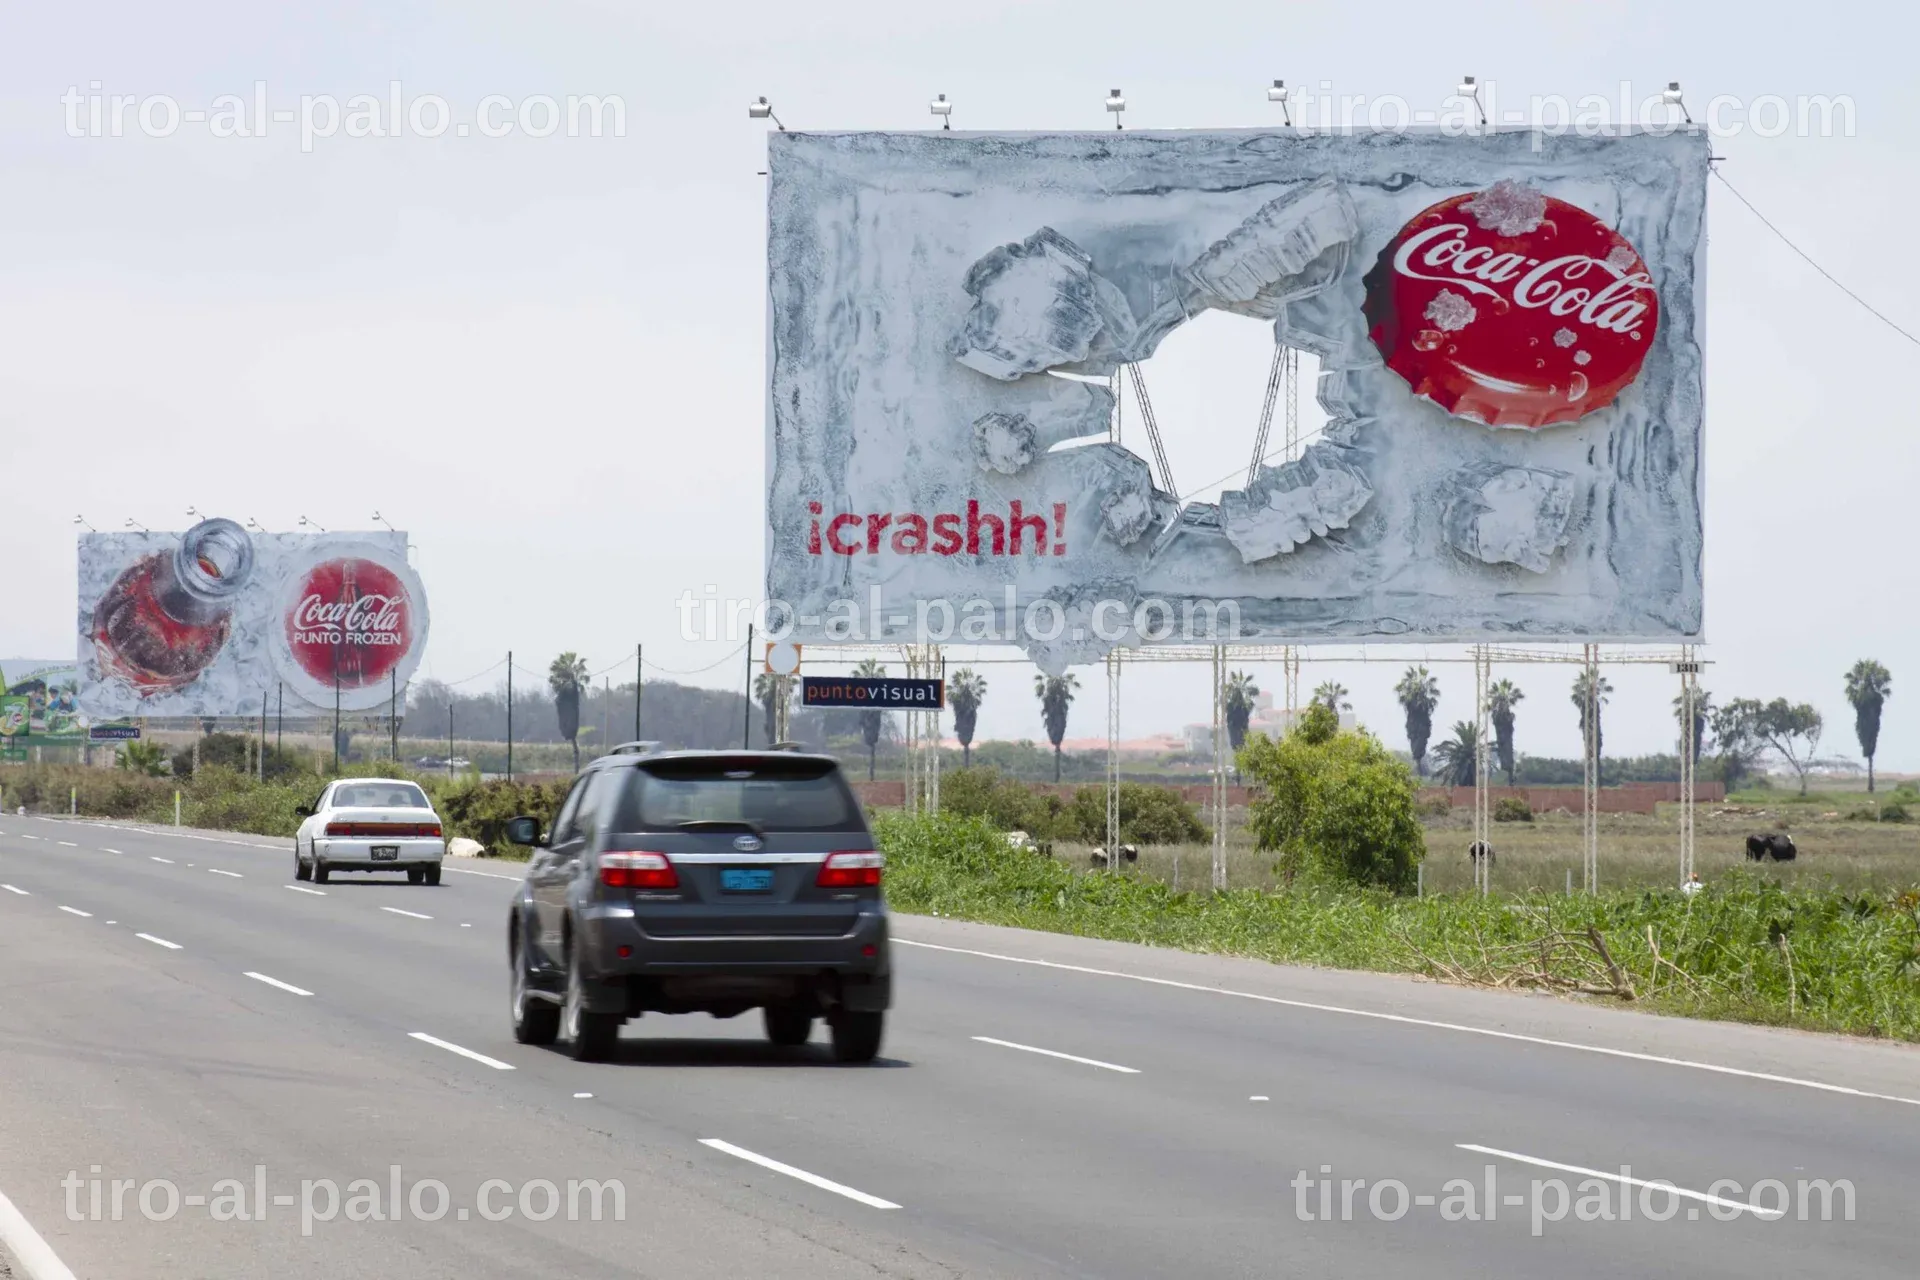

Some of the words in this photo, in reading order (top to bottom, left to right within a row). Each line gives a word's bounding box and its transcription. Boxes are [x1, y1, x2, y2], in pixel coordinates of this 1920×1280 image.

[1393, 223, 1656, 333] Coca-Cola
[294, 594, 403, 631] Coca-Cola
[294, 631, 341, 644] PUNTO
[345, 631, 402, 645] FROZEN
[807, 684, 937, 701] puntovisual
